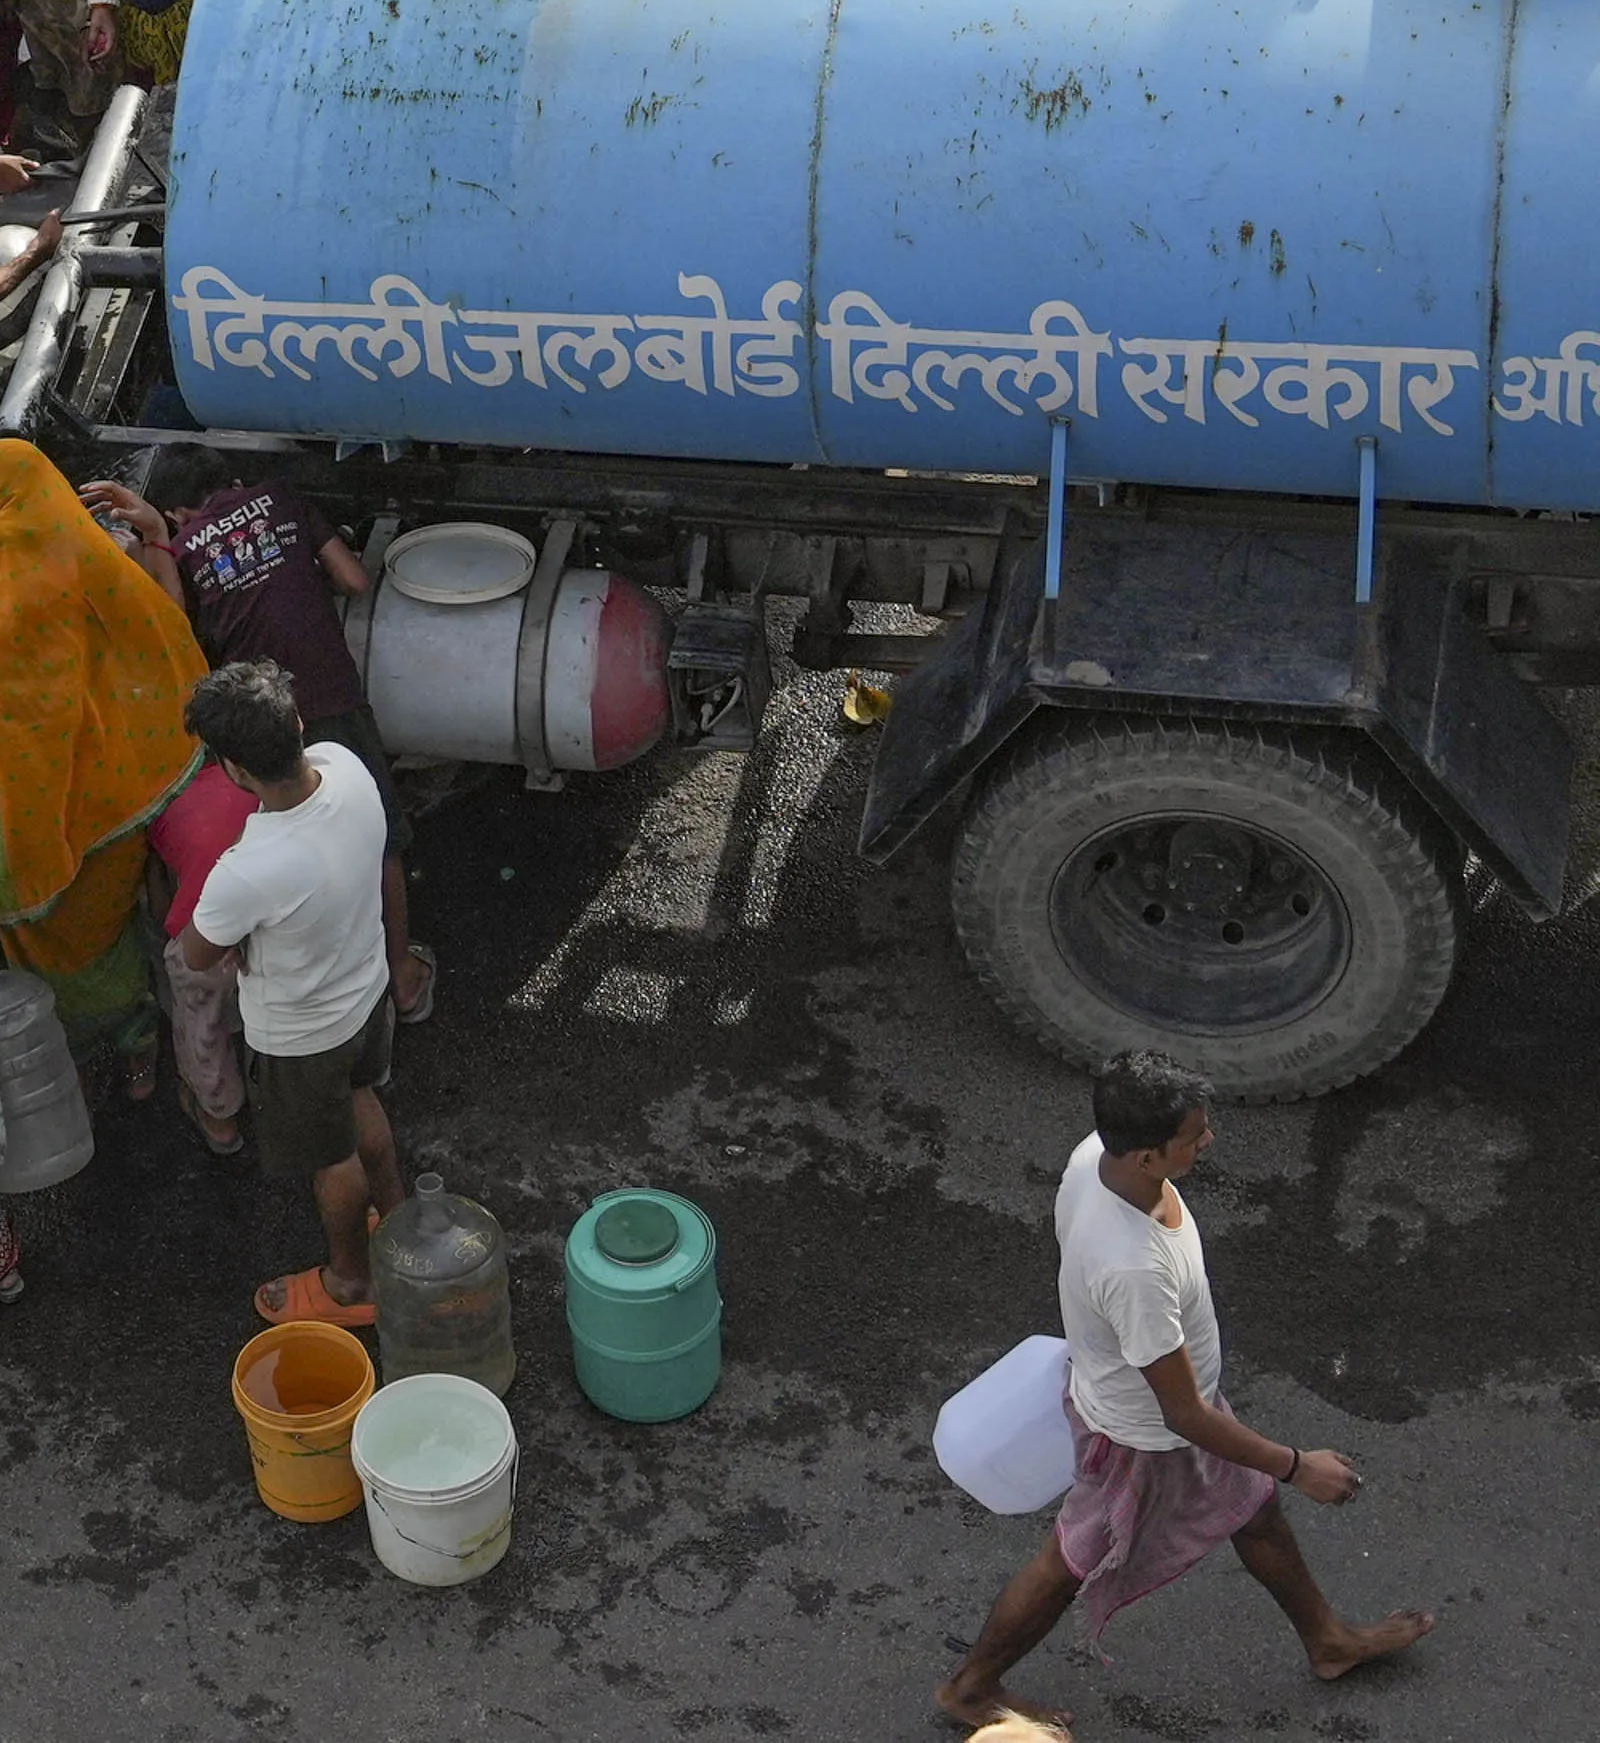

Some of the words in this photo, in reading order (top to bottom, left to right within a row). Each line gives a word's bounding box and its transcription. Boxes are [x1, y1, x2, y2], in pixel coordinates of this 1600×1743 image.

[172, 265, 457, 385] दिल्ली
[452, 308, 636, 394] जल
[633, 270, 804, 398] बोर्ड
[815, 290, 1113, 418] दिल्ली
[1119, 337, 1479, 437] सरकार
[185, 494, 274, 552] WASSUP
